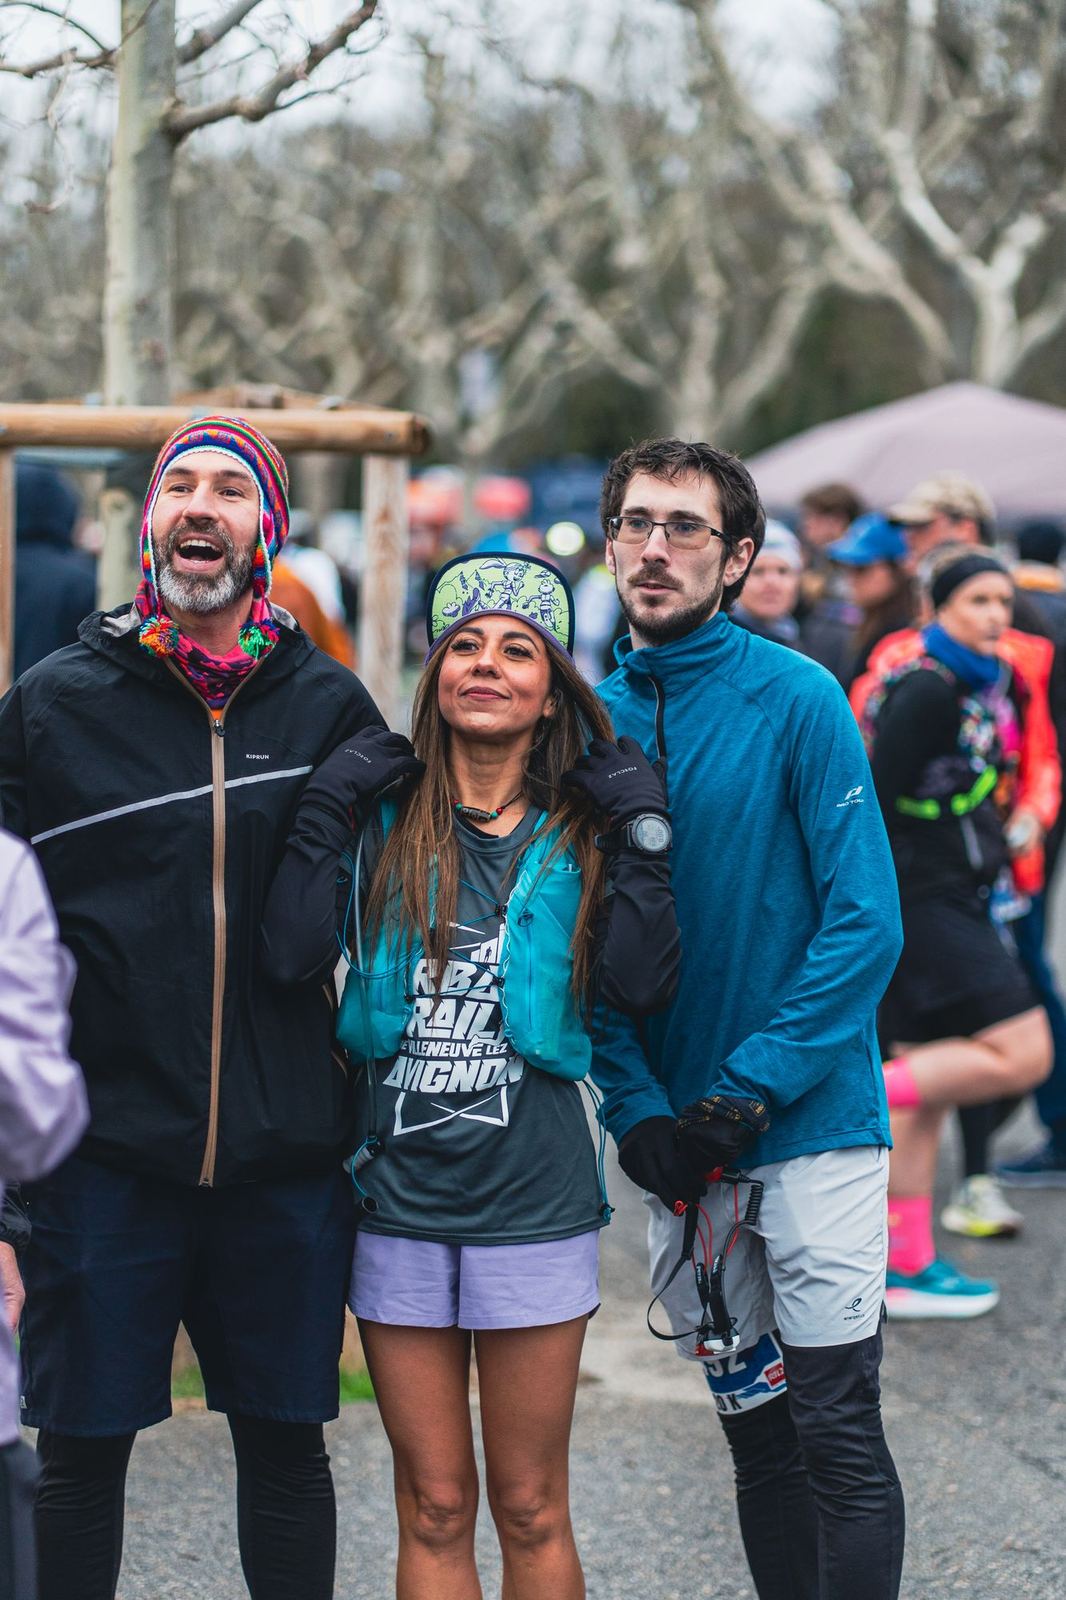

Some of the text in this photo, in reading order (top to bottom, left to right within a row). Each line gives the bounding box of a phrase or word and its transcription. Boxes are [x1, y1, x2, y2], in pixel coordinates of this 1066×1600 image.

[406, 997, 495, 1041] RAIL
[485, 1043, 508, 1055] LEZ
[382, 1056, 525, 1093] AVIGNON
